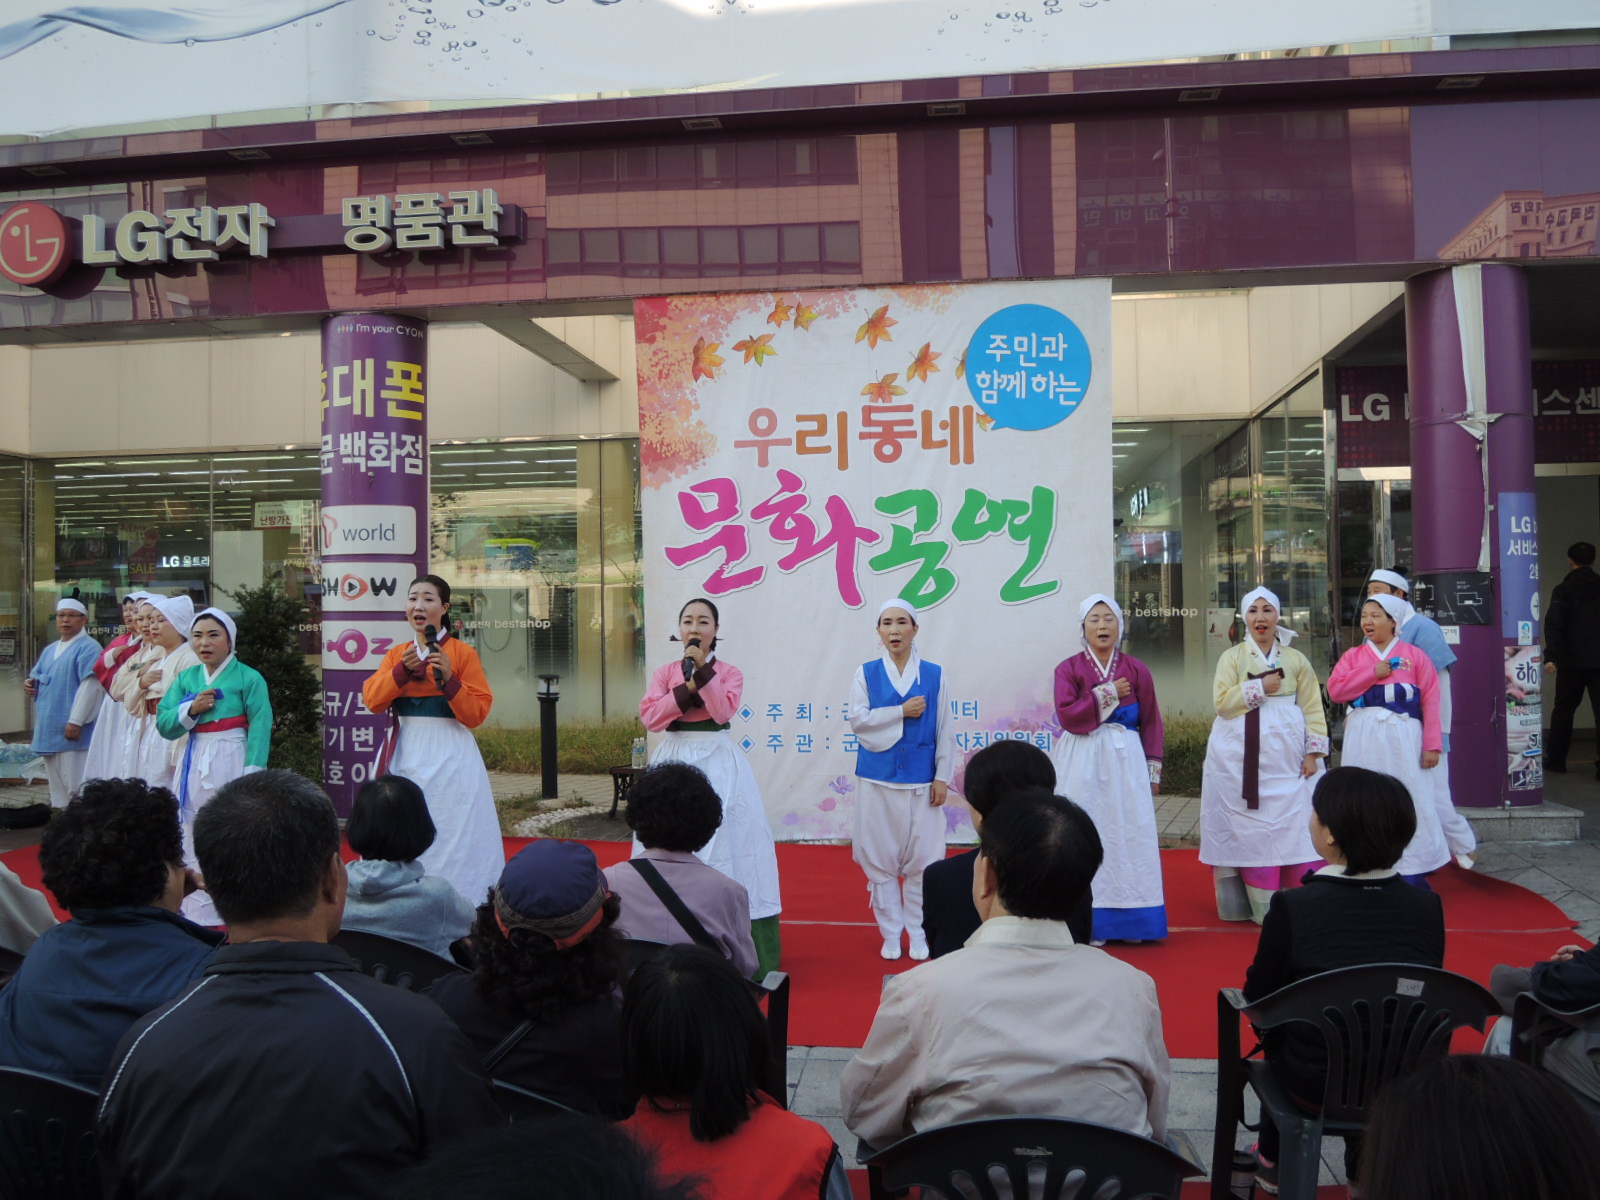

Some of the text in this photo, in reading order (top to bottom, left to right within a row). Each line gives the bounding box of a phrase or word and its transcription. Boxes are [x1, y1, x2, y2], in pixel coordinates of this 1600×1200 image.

[82, 188, 503, 266] LG전자 명품관
[355, 323, 424, 340] I'm your CYON
[985, 333, 1068, 367] 주민과
[976, 370, 1082, 406] 함께 하는
[1341, 393, 1390, 421] LG
[342, 523, 395, 542] world
[1511, 516, 1531, 533] LG
[162, 556, 180, 567] LG
[1135, 607, 1198, 618] bestshop
[494, 619, 551, 630] bestshop
